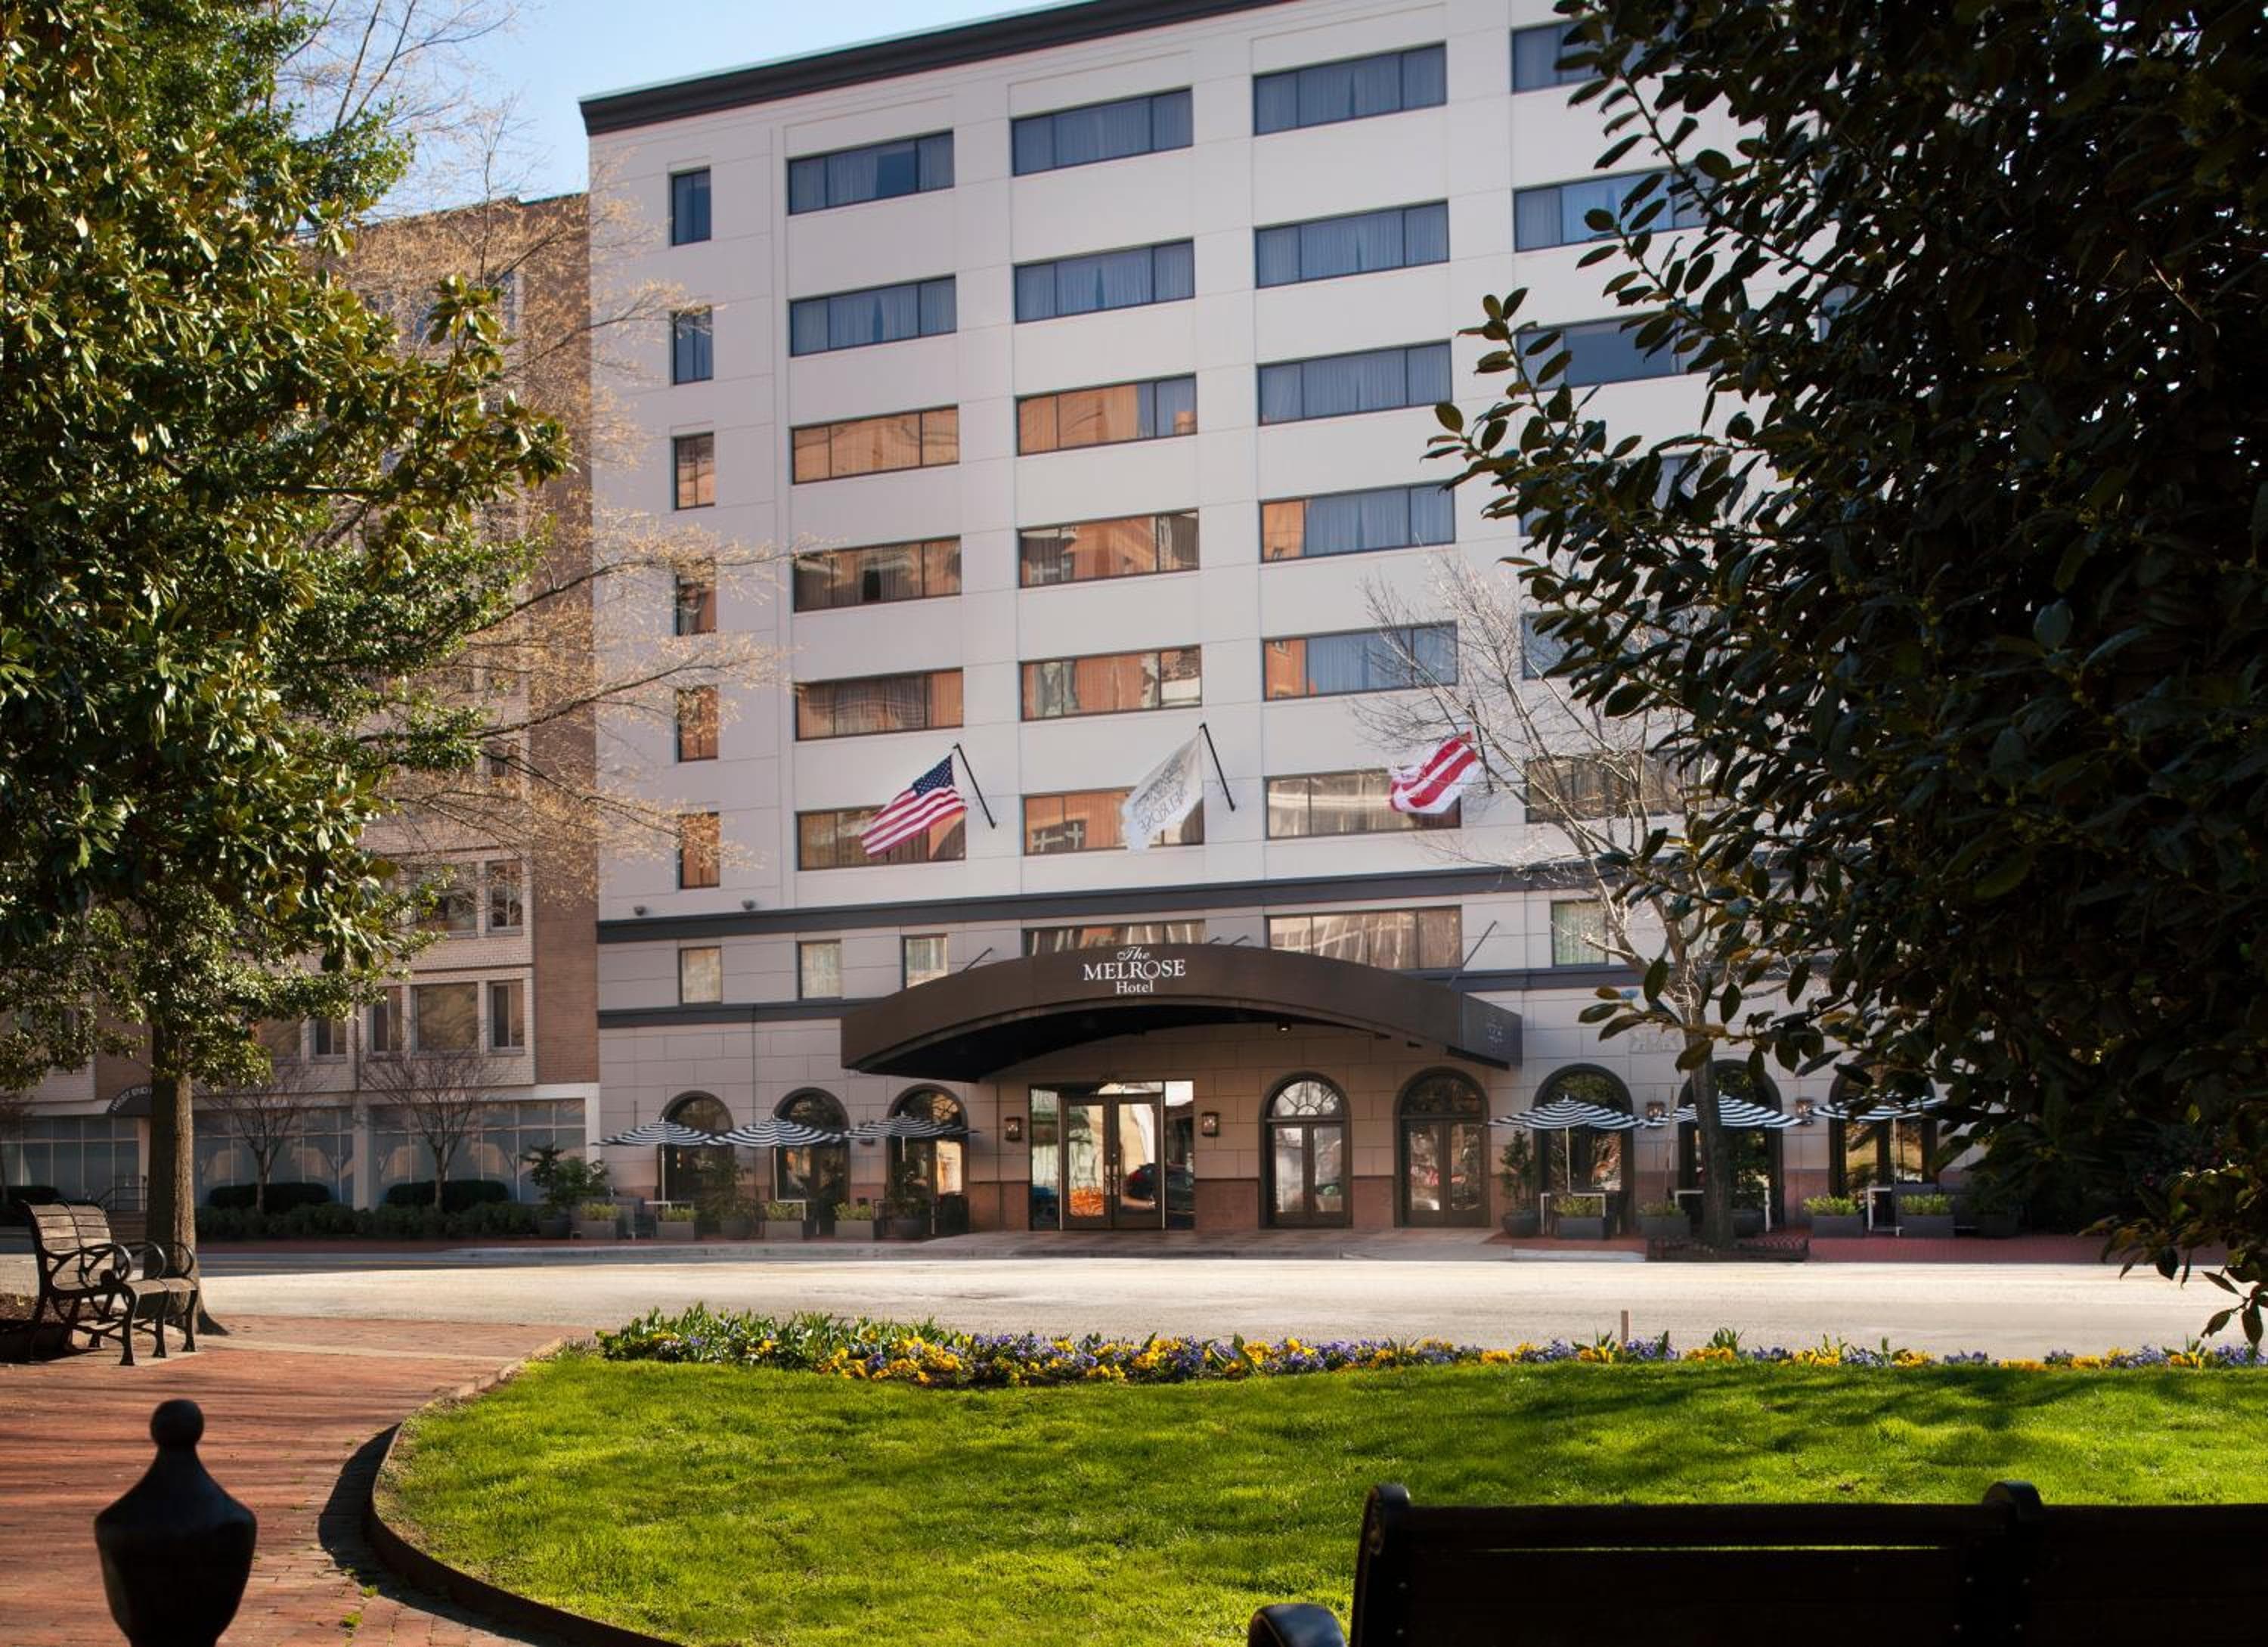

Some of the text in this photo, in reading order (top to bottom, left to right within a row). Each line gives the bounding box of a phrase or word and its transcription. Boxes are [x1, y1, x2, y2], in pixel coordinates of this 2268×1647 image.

[1116, 946, 1151, 961] The
[1083, 958, 1186, 981] MELROSE
[1115, 980, 1154, 994] Hotel
